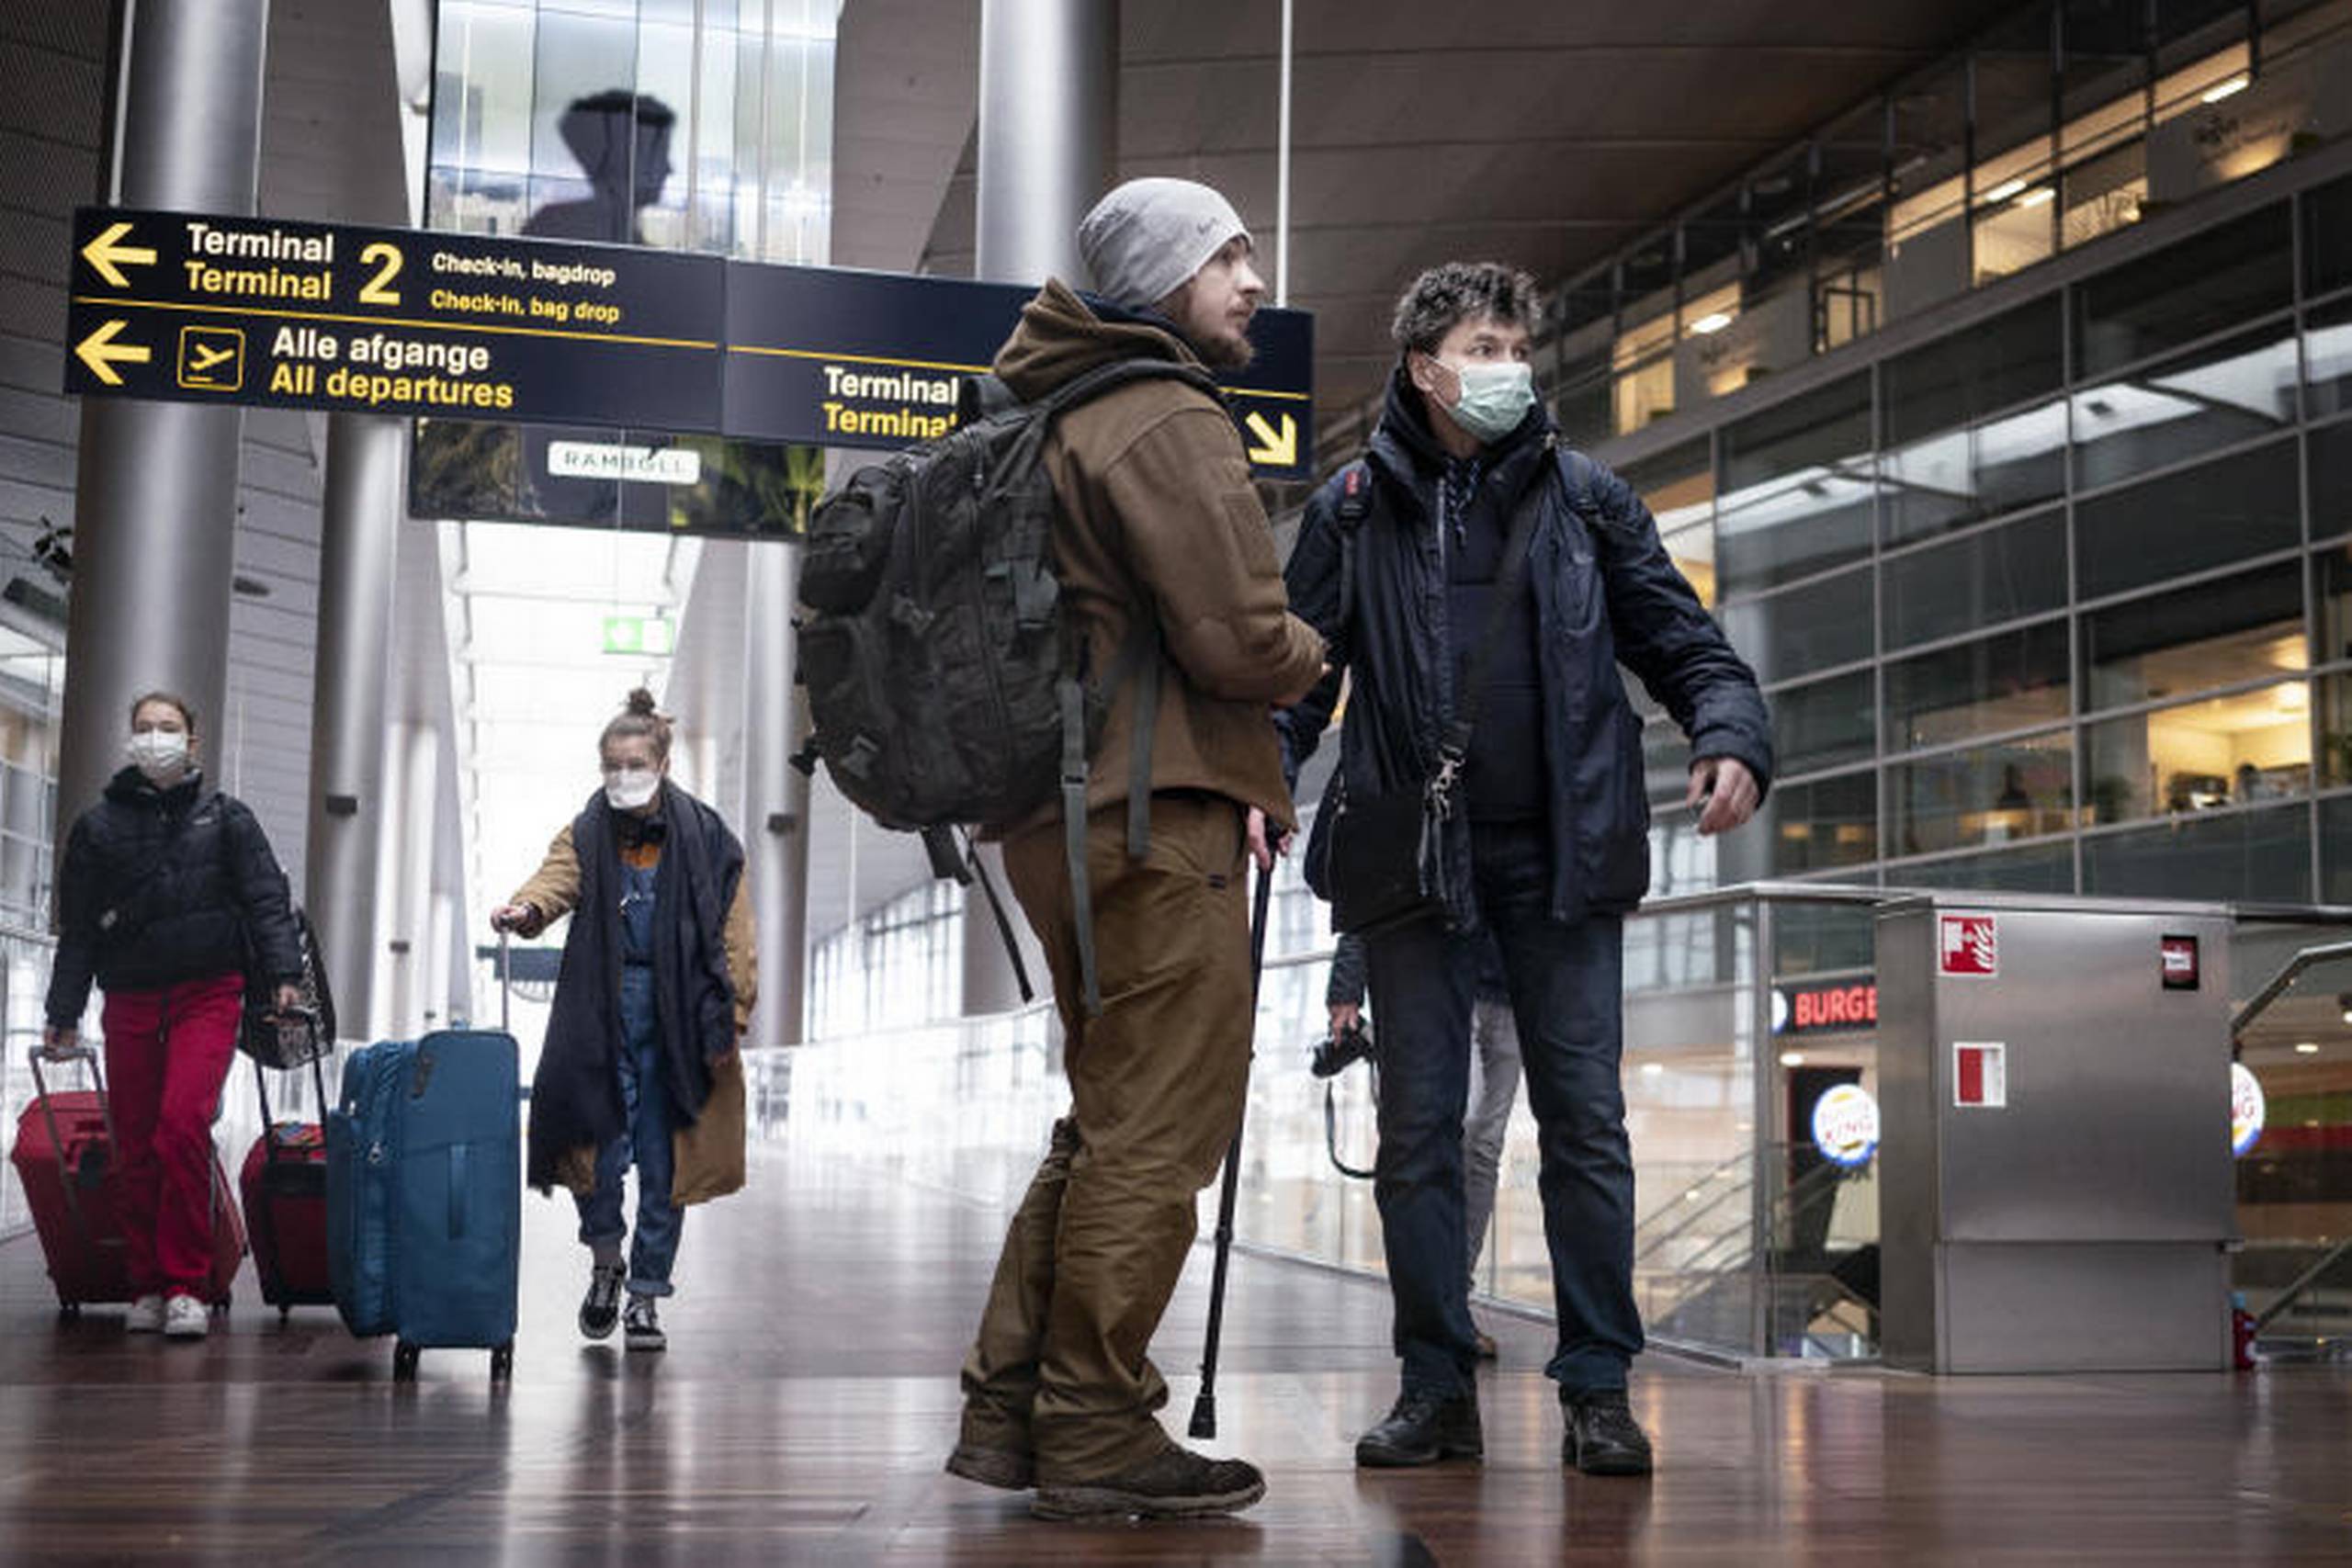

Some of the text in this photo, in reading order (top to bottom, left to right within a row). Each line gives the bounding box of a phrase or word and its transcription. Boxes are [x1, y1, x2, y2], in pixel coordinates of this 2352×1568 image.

[186, 222, 334, 263] Terminal
[184, 261, 332, 300] Terminal
[358, 243, 404, 305] 2
[432, 252, 616, 288] Check-in, bagdrop
[530, 299, 569, 321] bag
[574, 302, 619, 324] drop
[271, 327, 490, 373] Alle afgange
[270, 363, 514, 409] All departures
[824, 366, 959, 405] Terminal
